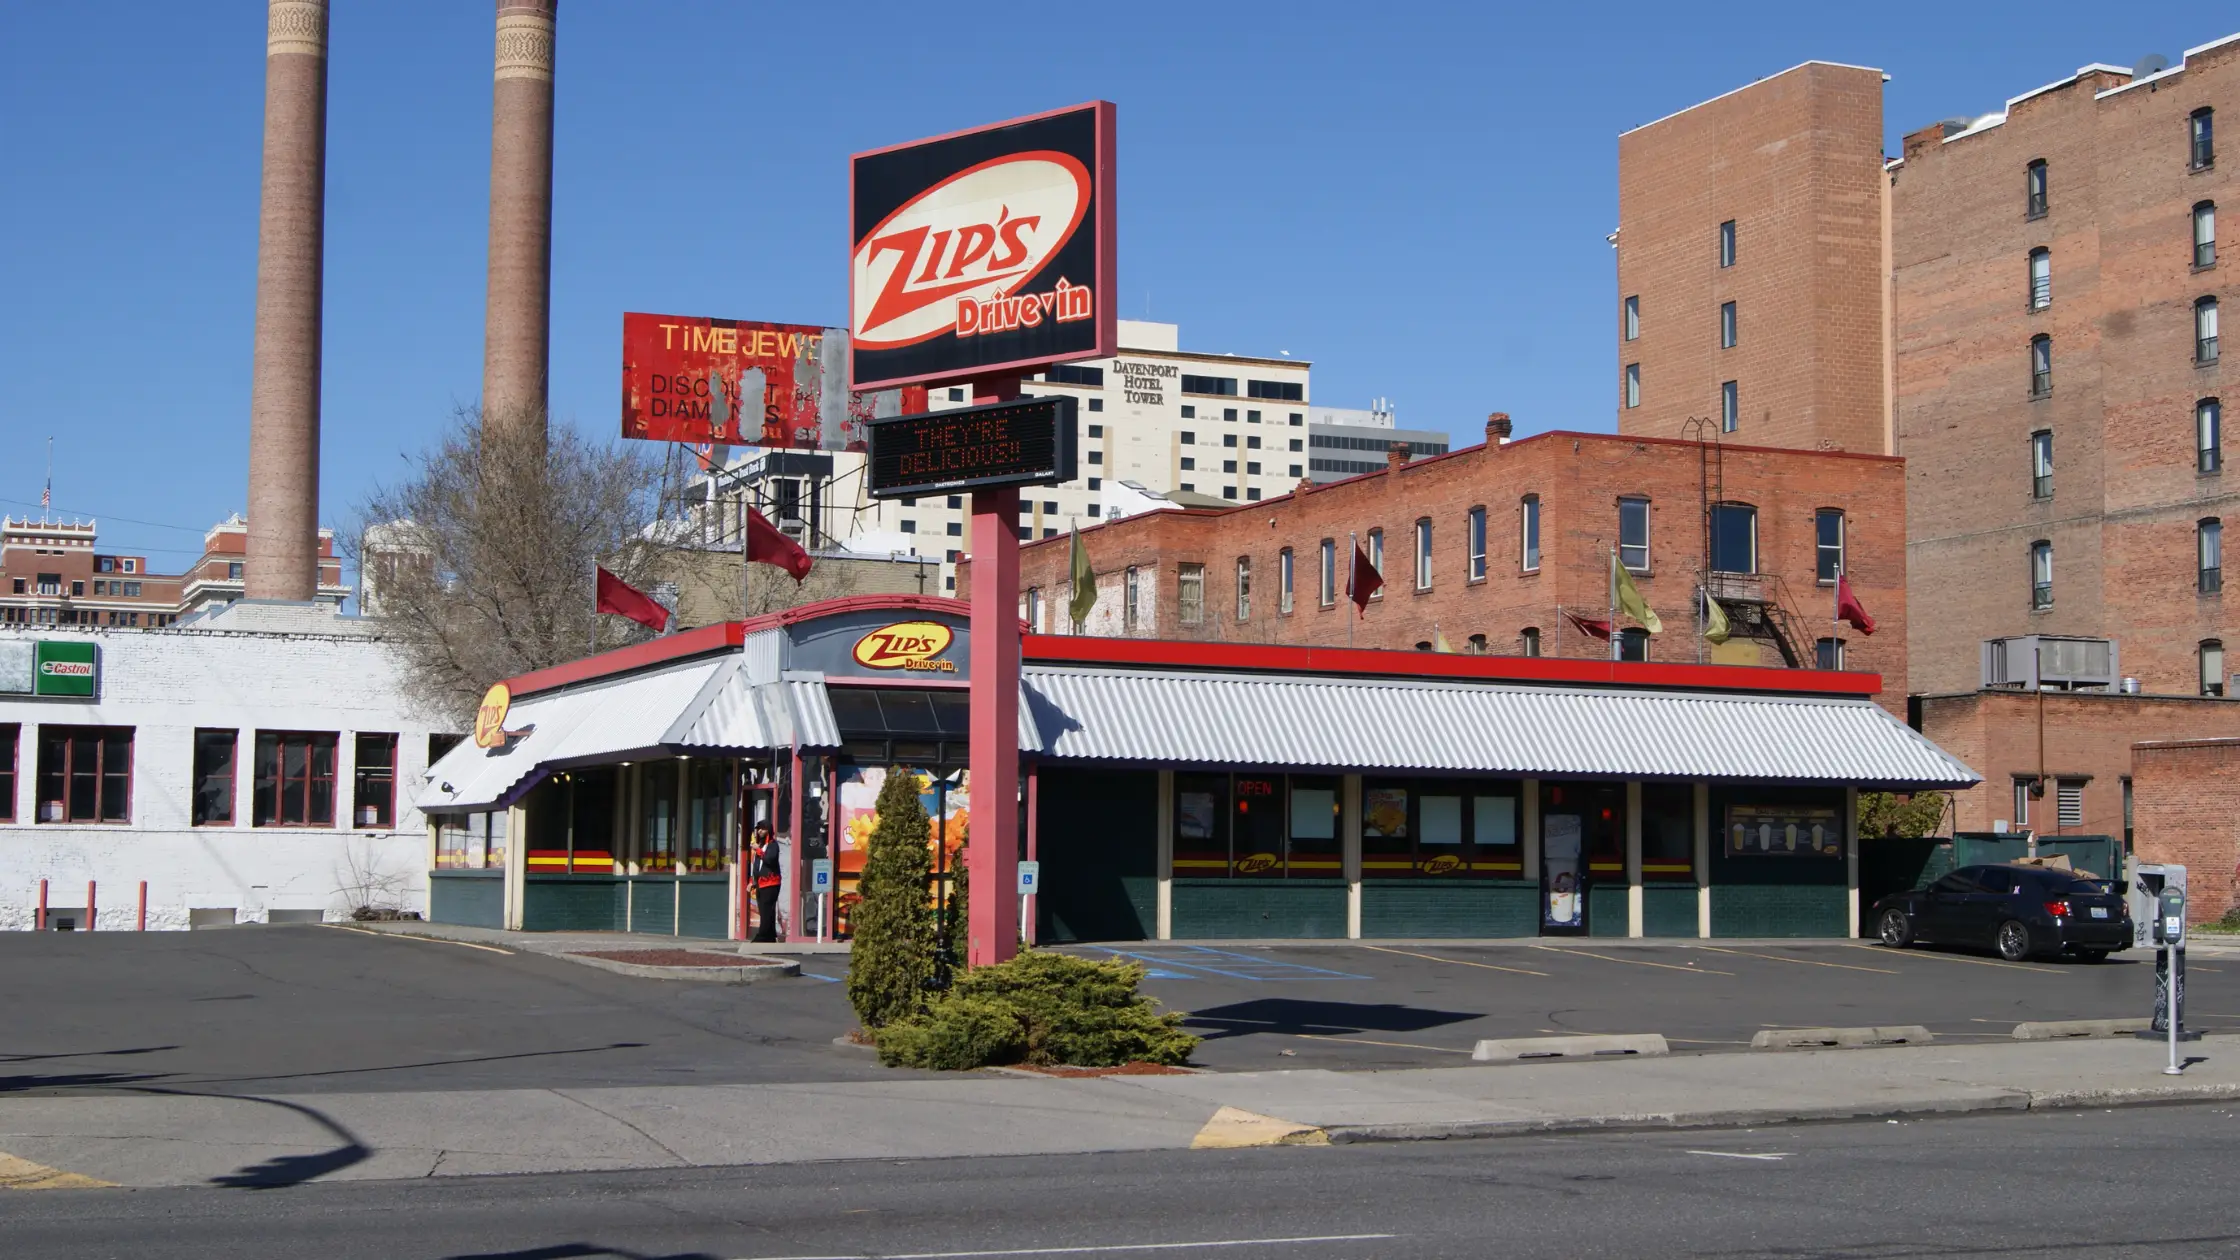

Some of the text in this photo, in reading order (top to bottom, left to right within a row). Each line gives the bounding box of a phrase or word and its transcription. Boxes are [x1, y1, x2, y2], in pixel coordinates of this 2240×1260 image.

[1113, 360, 1179, 378] DAVENPORT
[1124, 375, 1163, 391] HOTEL
[1124, 390, 1164, 405] TOWER
[915, 419, 1008, 449] THEY'RE
[54, 663, 91, 674] Castrol
[1237, 780, 1272, 796] OPEN
